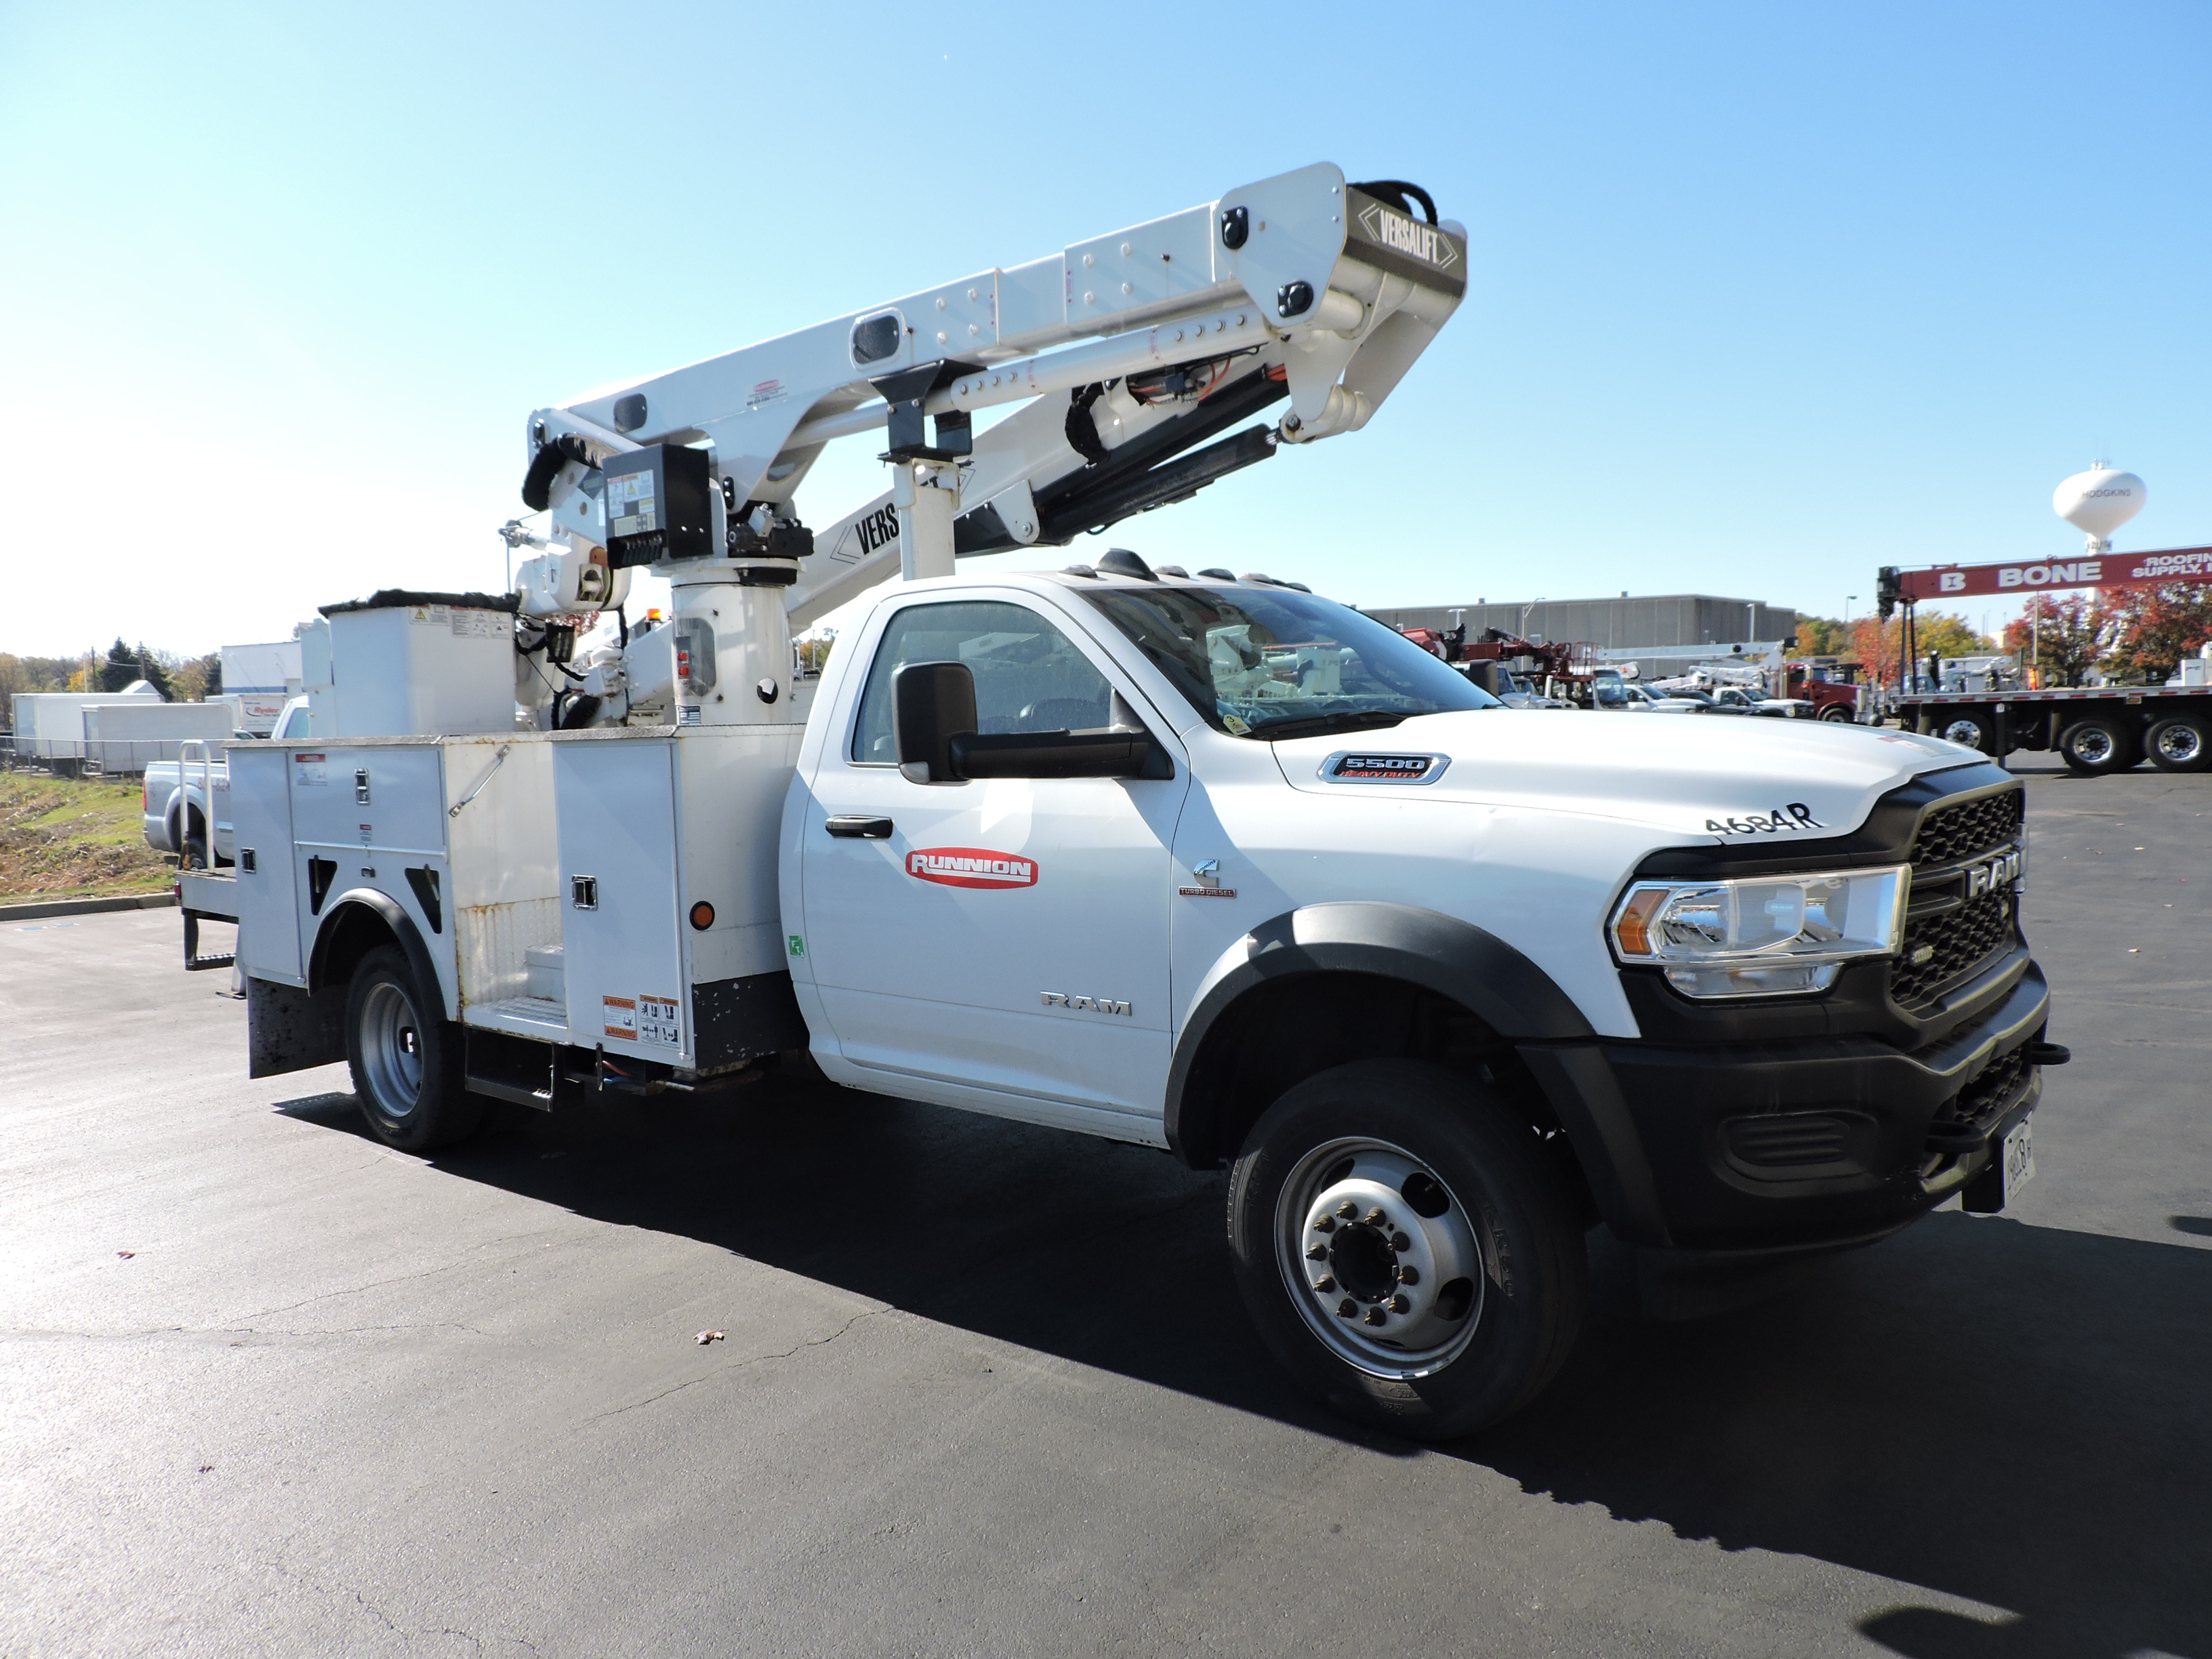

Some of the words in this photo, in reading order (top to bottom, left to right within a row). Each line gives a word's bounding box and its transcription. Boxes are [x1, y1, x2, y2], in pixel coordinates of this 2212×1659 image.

[1380, 209, 1438, 264] VERSALIFT
[2083, 489, 2131, 499] HODGKINS
[1999, 561, 2102, 588] BONE
[2132, 563, 2203, 577] SUPPLY,
[1346, 758, 1425, 770] 5500
[1339, 770, 1383, 778] HEAVY
[1705, 802, 1825, 835] 4684R
[912, 854, 1031, 879] RUNNION
[1193, 859, 1216, 876] Cummins
[1969, 851, 2020, 897] RAM
[609, 999, 635, 1009] WARNING
[1040, 990, 1133, 1017] RAM
[610, 1027, 636, 1038] WARNING
